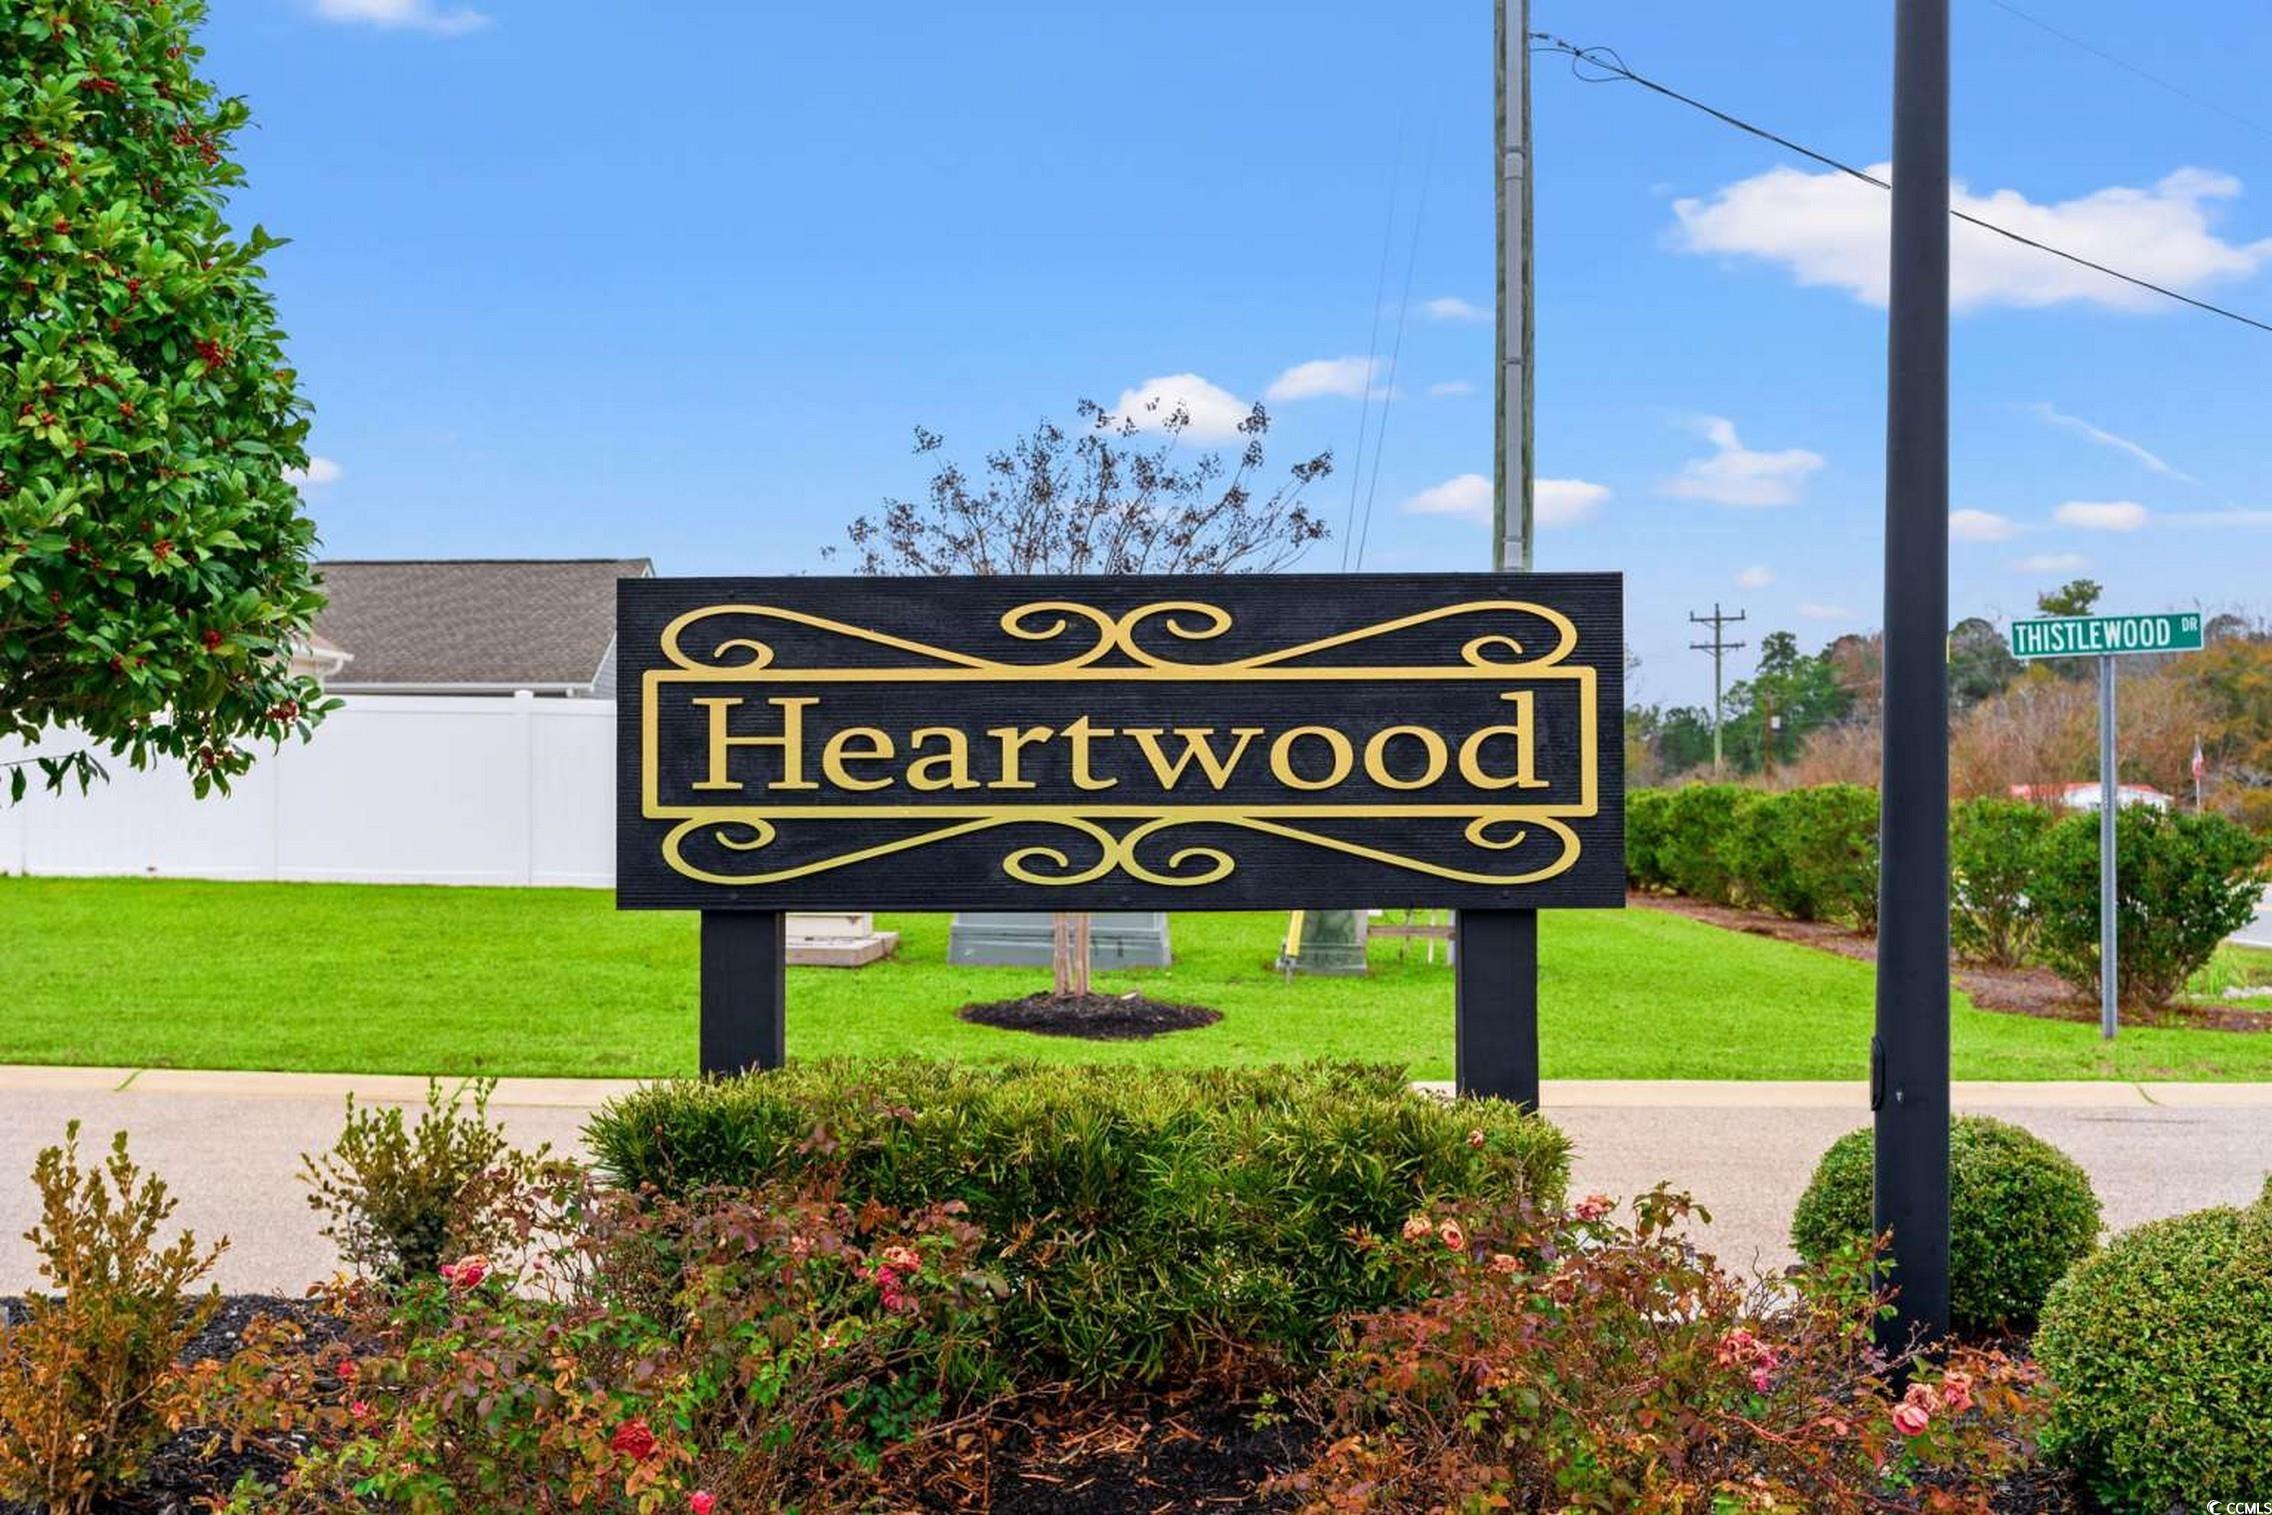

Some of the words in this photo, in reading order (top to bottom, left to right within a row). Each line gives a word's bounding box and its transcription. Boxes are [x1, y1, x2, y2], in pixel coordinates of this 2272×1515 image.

[2015, 618, 2171, 652] THISTLEWOOD
[2181, 616, 2198, 632] DR
[690, 690, 1550, 792] Heartwood
